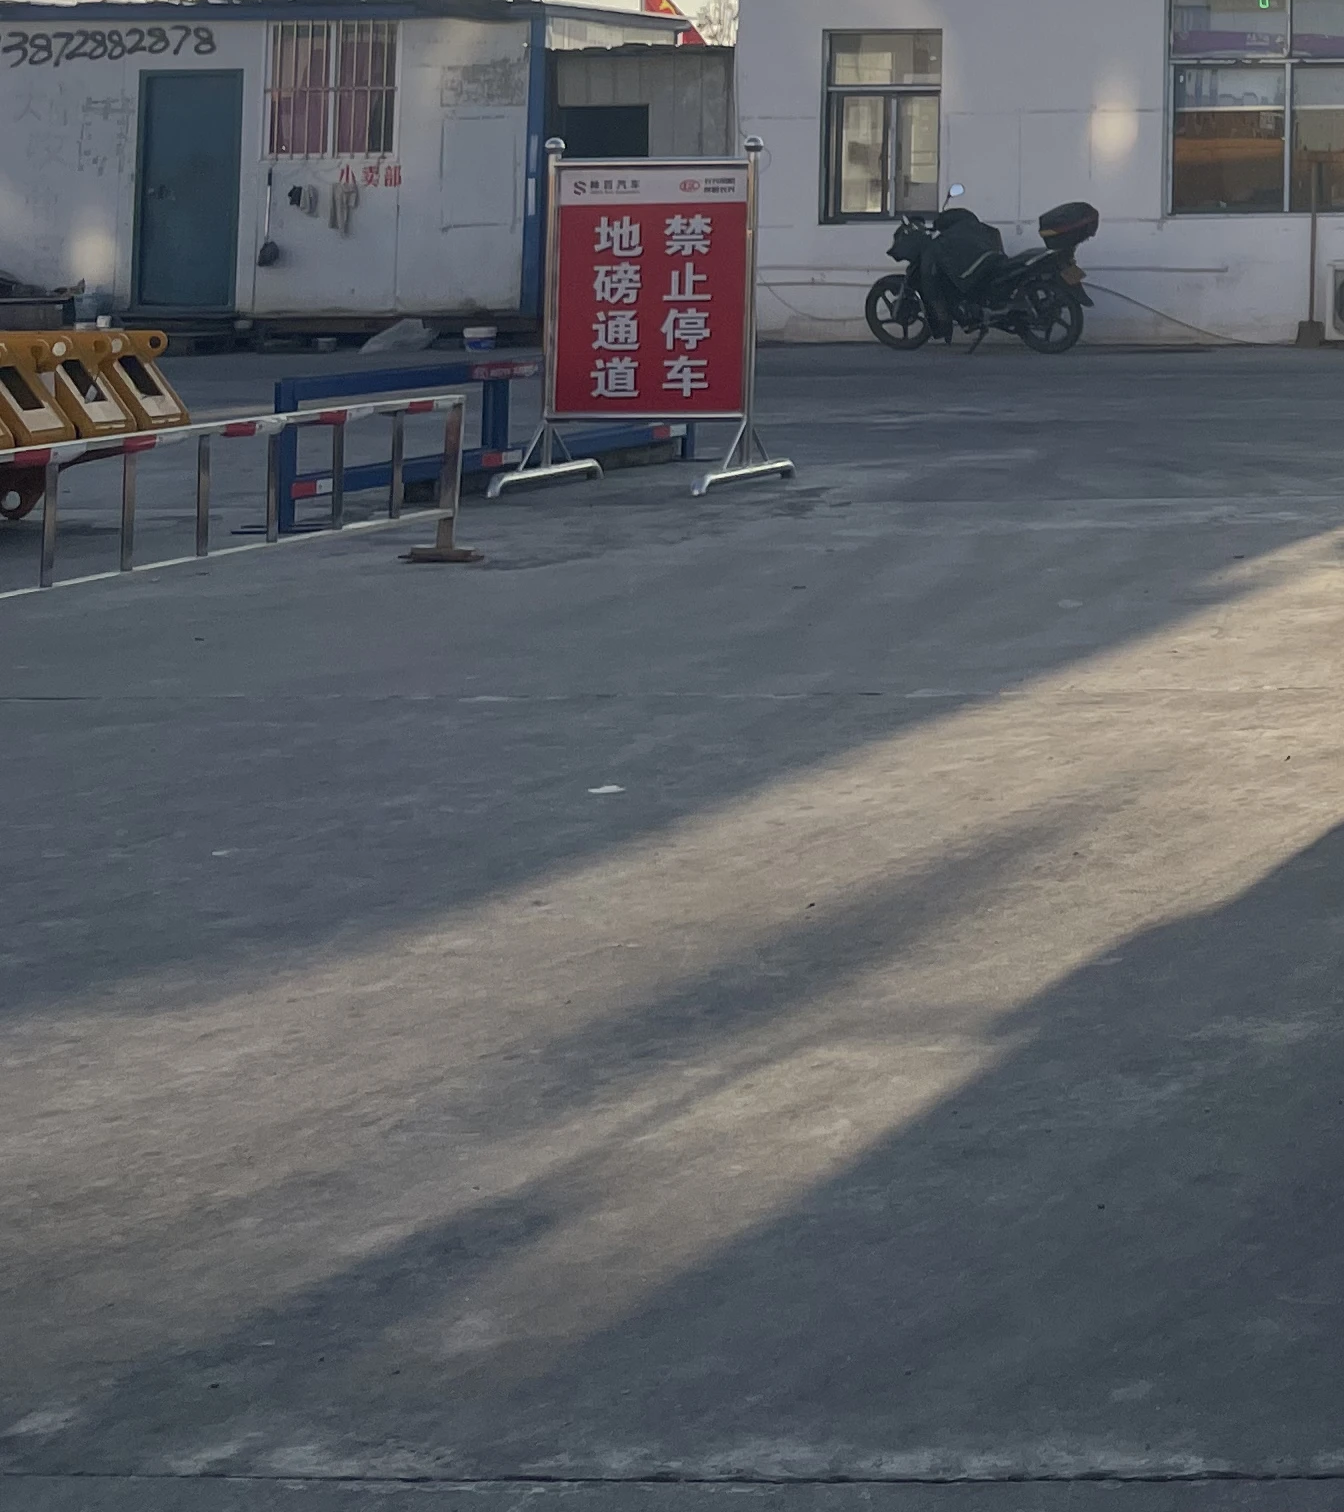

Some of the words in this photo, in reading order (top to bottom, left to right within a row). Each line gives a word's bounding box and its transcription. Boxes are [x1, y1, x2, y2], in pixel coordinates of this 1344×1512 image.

[0, 25, 217, 68] 3872882878
[590, 215, 644, 399] 地磅通道
[660, 214, 713, 398] 禁止停车
